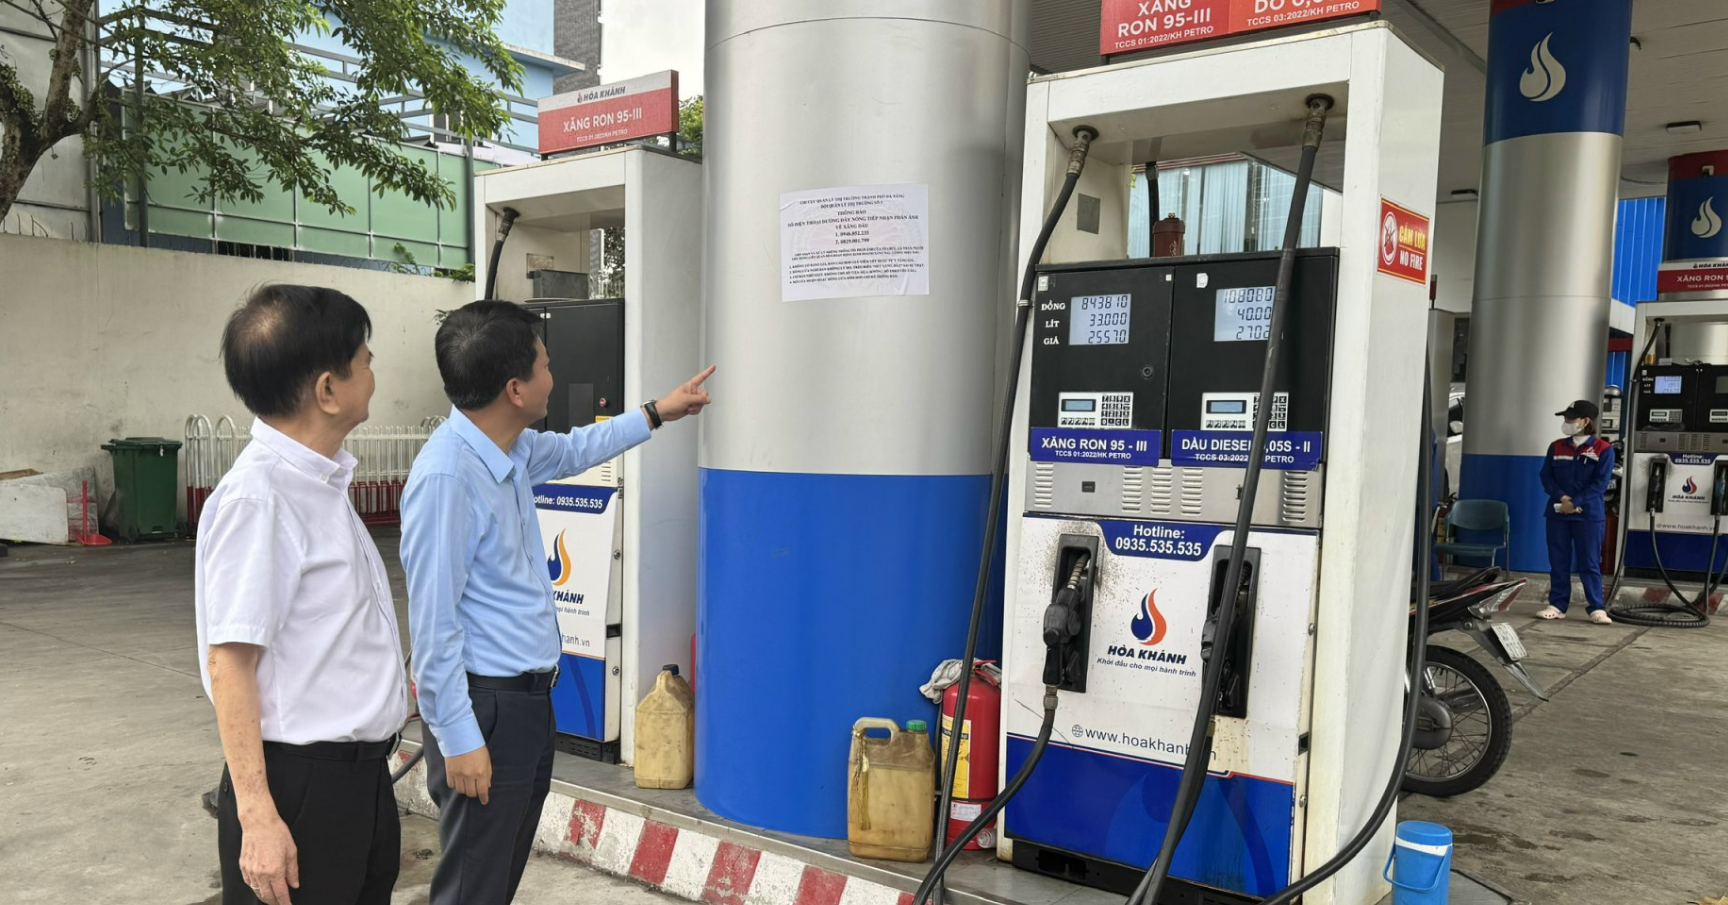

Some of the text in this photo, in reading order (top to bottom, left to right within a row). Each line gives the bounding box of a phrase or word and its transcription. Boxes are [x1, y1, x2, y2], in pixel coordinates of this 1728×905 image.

[1247, 16, 1271, 26] TCCS
[1326, 1, 1360, 13] PETRO
[1118, 8, 1211, 37] RON 95-III
[1115, 39, 1136, 49] TCCS
[1184, 26, 1214, 37] PETRO
[563, 107, 642, 133] XĂNG RON 95-III
[1400, 250, 1423, 271] NO FIRE
[1082, 295, 1128, 310] 843810
[1224, 287, 1273, 303] 108080
[1237, 307, 1272, 321] 40.00
[1045, 319, 1060, 328] LÍT
[1088, 329, 1127, 344] 25570
[1236, 325, 1270, 340] 2702
[1043, 336, 1060, 345] GIÁ
[1042, 436, 1076, 449] XĂNG
[1080, 438, 1107, 450] RON
[1110, 440, 1125, 451] 95
[1136, 440, 1147, 452] III
[1303, 441, 1311, 453] II
[1218, 454, 1249, 462] 03:2022
[1265, 455, 1294, 463] PETRO
[534, 495, 603, 509] otline: 0935.535.535
[1133, 524, 1186, 539] Hotline:
[1115, 537, 1202, 556] 0935.535.535
[1107, 644, 1187, 665] HÒA KHÁNH
[1129, 662, 1143, 670] cho
[1144, 664, 1158, 672] mọi
